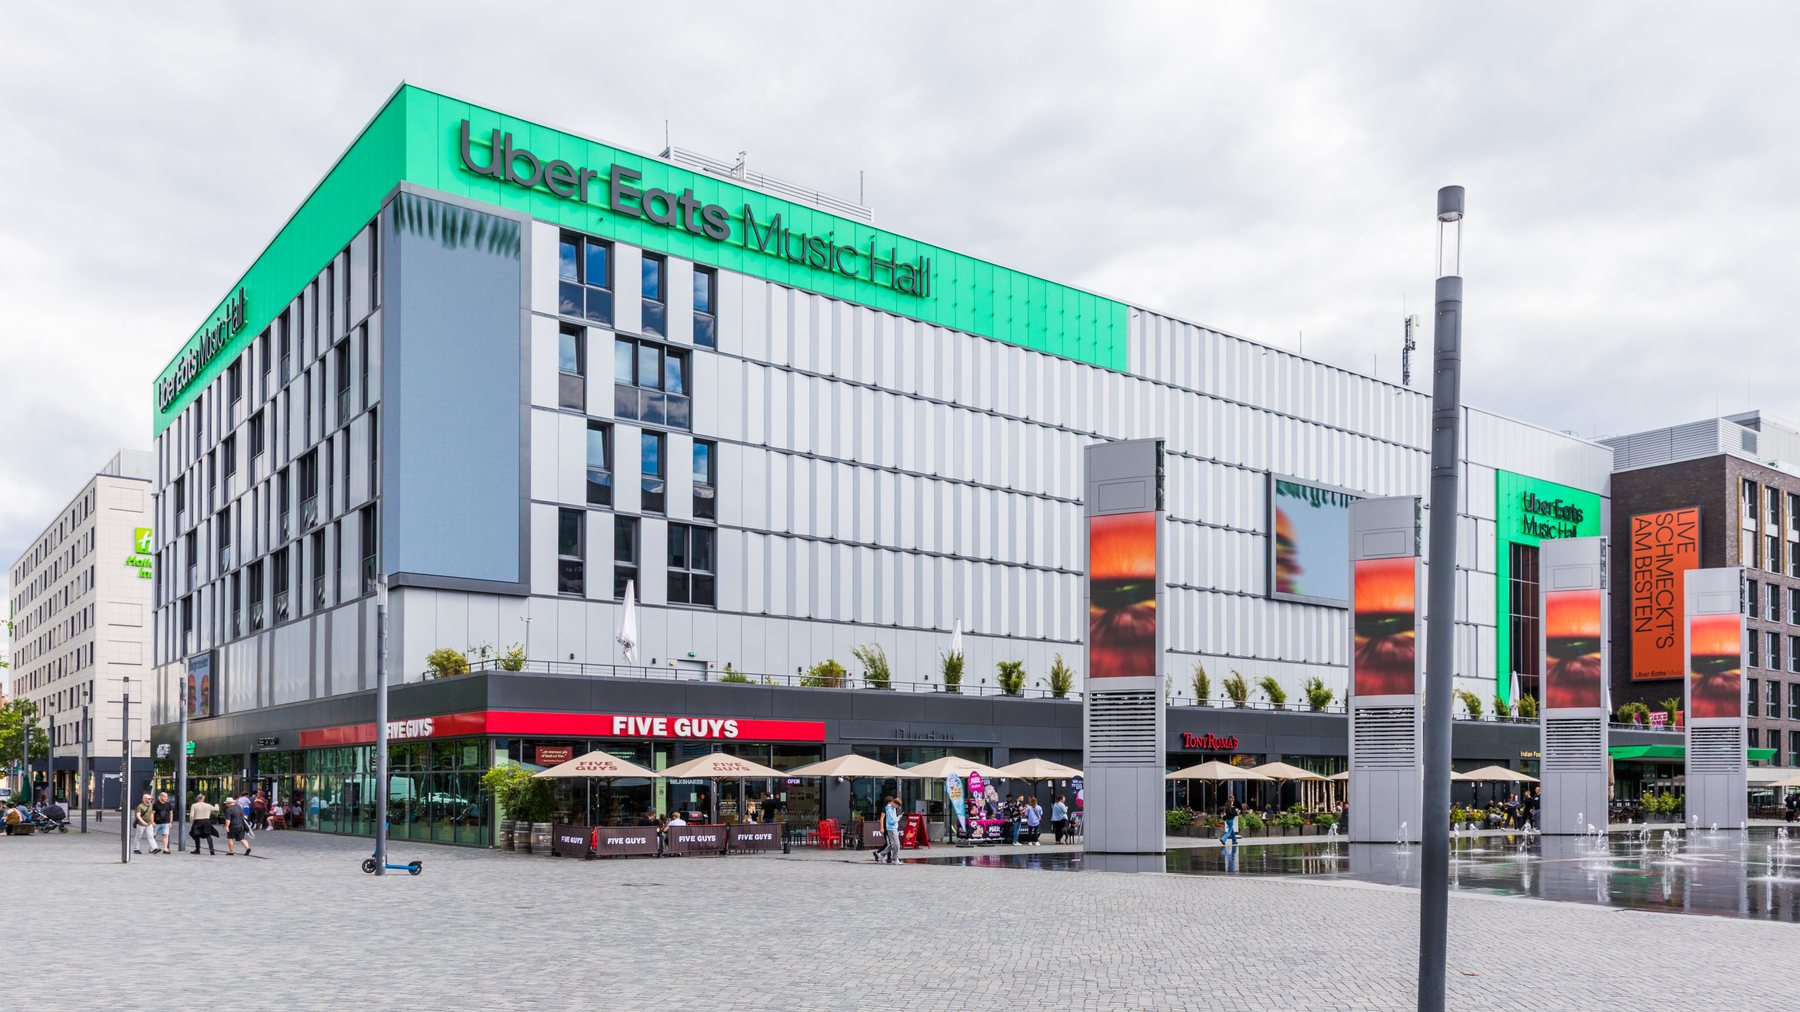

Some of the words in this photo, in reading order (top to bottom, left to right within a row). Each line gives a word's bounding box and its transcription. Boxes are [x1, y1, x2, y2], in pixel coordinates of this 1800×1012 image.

[460, 119, 597, 202] Uber
[610, 163, 730, 241] Eats
[743, 204, 859, 278] Music
[869, 240, 931, 298] Hall
[158, 372, 178, 413] Uber
[177, 349, 200, 393] Eats
[200, 317, 226, 369] Music
[226, 287, 245, 340] Hall
[1523, 491, 1553, 516] Uber
[1554, 499, 1584, 524] Eats
[1523, 514, 1557, 540] Music
[1558, 522, 1577, 539] Hall
[1634, 517, 1652, 552] AM
[1676, 510, 1695, 554] LIVE
[1634, 555, 1652, 633] BESTEN
[1655, 513, 1674, 649] SCHMECKT'S
[406, 718, 433, 738] GUYS
[613, 716, 668, 736] FIVE
[674, 718, 739, 738] GUYS
[561, 835, 570, 843] FIVE
[570, 836, 583, 844] GUYS
[679, 835, 696, 843] FIVE
